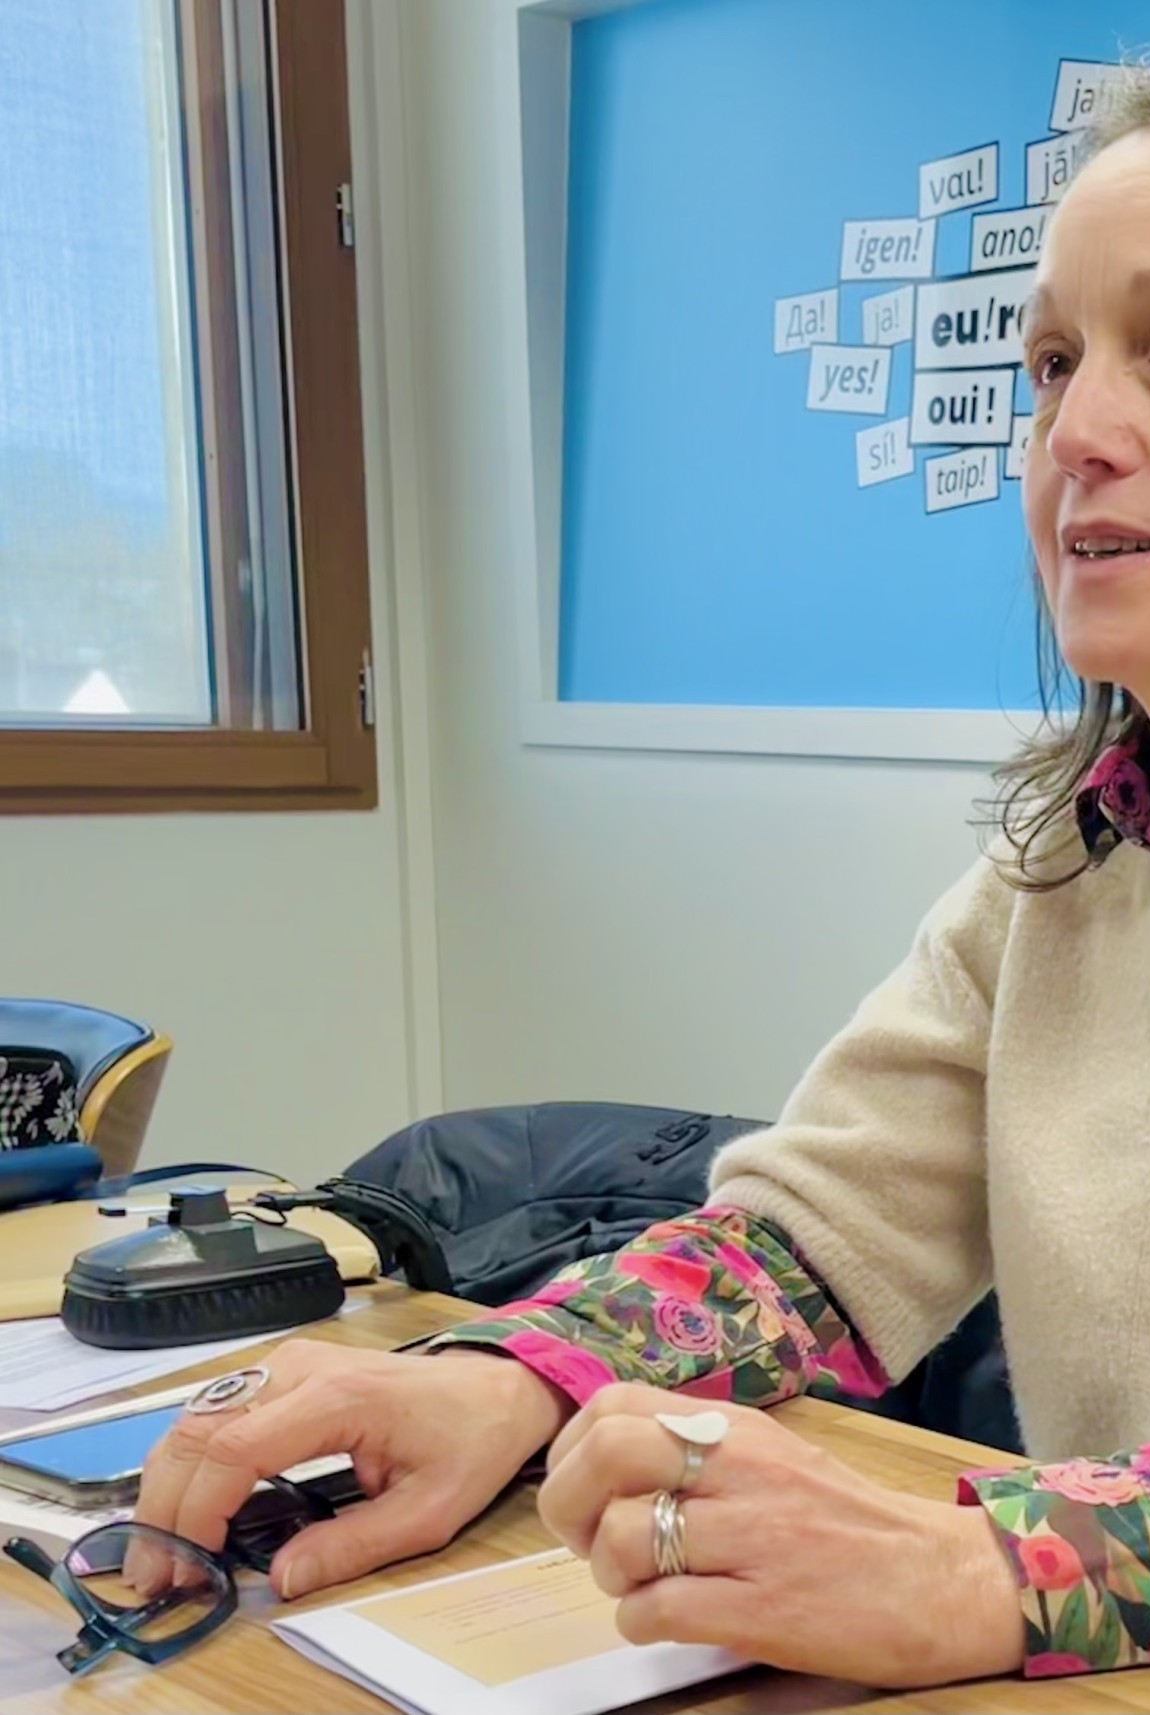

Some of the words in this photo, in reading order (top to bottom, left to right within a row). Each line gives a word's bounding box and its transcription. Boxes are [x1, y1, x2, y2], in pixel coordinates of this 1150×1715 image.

[855, 227, 922, 274] igen!
[982, 215, 1046, 258] ano!
[785, 298, 825, 347] Да!
[819, 360, 879, 402] yes!
[936, 455, 987, 498] taip!
